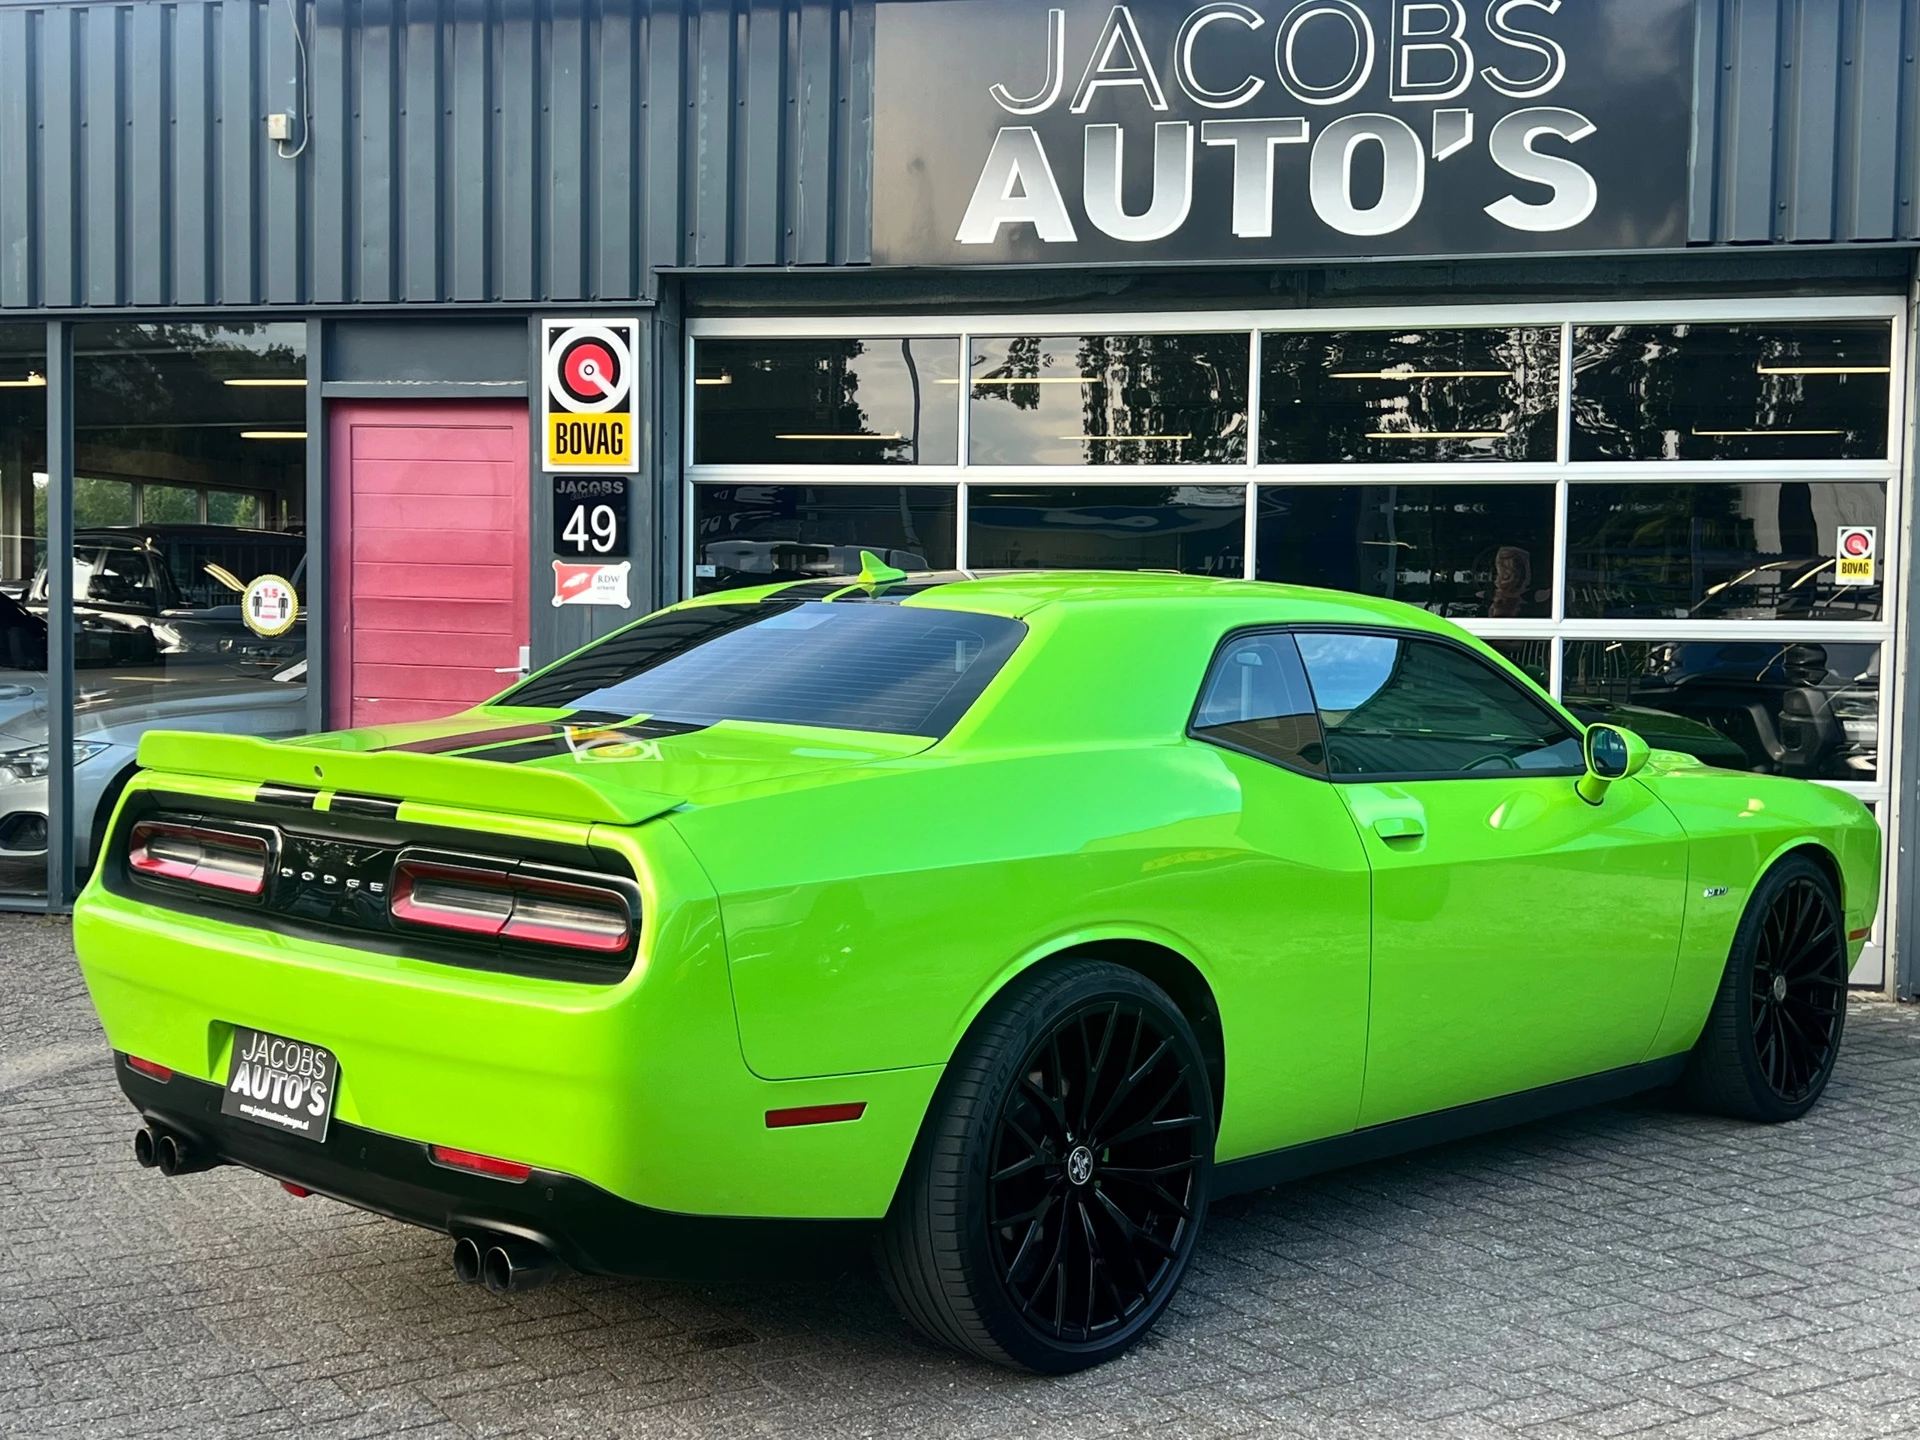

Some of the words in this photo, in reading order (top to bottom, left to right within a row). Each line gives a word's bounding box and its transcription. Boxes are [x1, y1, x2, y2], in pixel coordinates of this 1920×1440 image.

[989, 0, 1566, 115] JACOBS
[955, 106, 1597, 244] AUTO'S
[556, 422, 623, 455] BOVAG
[556, 480, 623, 494] JACOBS
[562, 504, 617, 552] 49
[597, 574, 620, 583] RDW
[1841, 562, 1869, 574] BOVAG
[263, 588, 279, 598] 1.5
[280, 867, 384, 892] DODGE
[241, 1032, 327, 1079] JACOBS
[230, 1061, 327, 1117] AUTO'S
